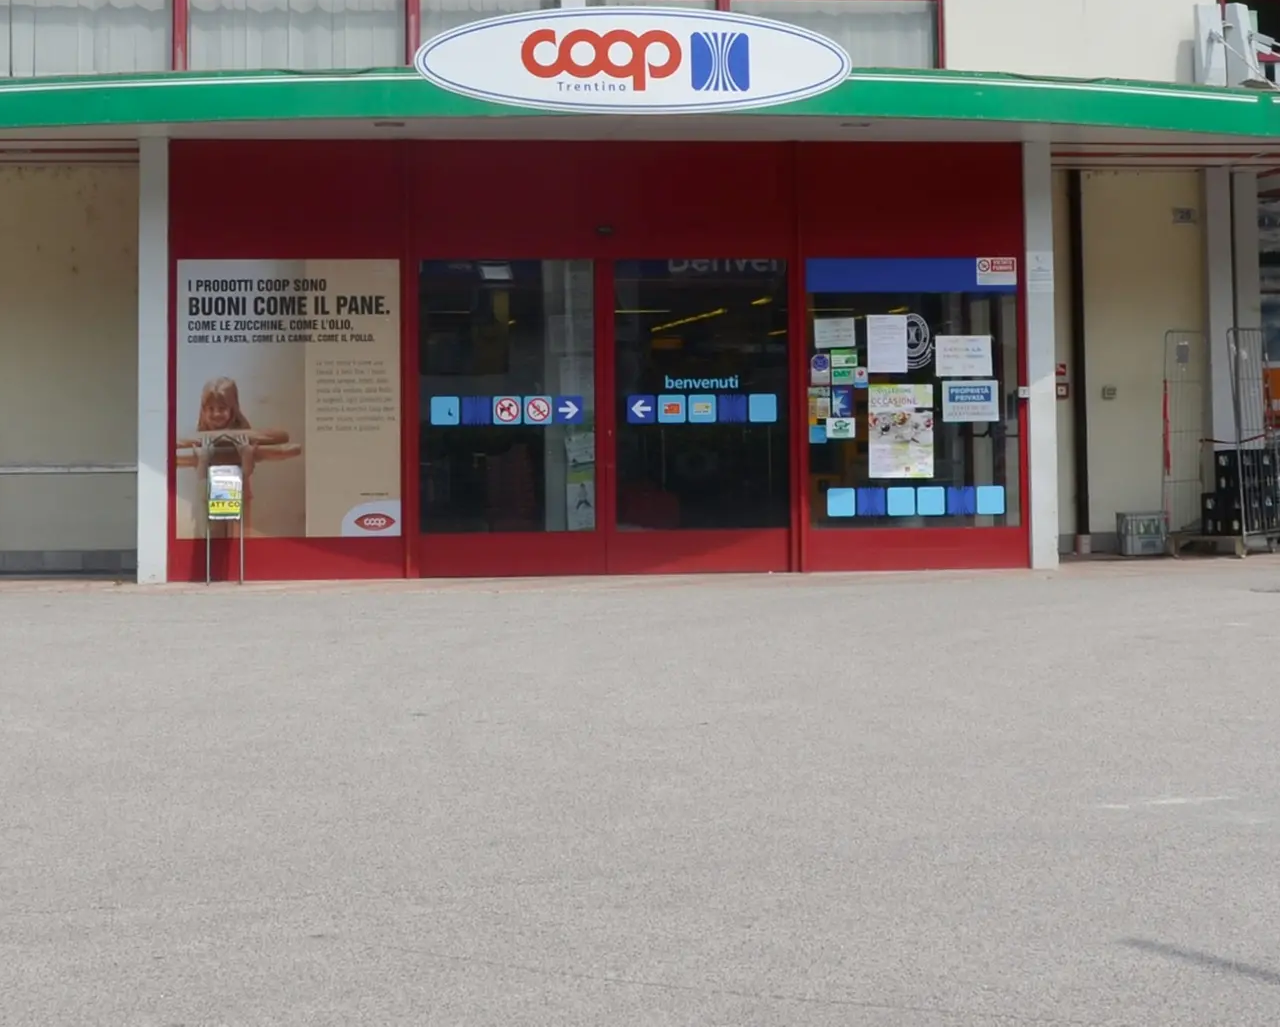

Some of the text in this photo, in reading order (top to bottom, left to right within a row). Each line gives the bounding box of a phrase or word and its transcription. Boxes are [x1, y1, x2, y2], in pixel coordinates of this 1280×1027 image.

[521, 29, 682, 91] coop
[557, 81, 627, 92] Trentino
[196, 279, 253, 292] PRODOTTI
[257, 279, 290, 292] COOP
[294, 279, 327, 292] SONO
[188, 295, 391, 316] BUONI COME IL PANE.
[188, 319, 354, 332] COME LE ZUCCHINE, COME L'OLIO,
[187, 335, 210, 344] COME
[212, 335, 222, 344] LA
[252, 334, 274, 343] COME
[276, 334, 286, 343] LA
[318, 334, 339, 343] COME
[665, 374, 739, 389] benvenuti
[364, 518, 387, 528] coop
